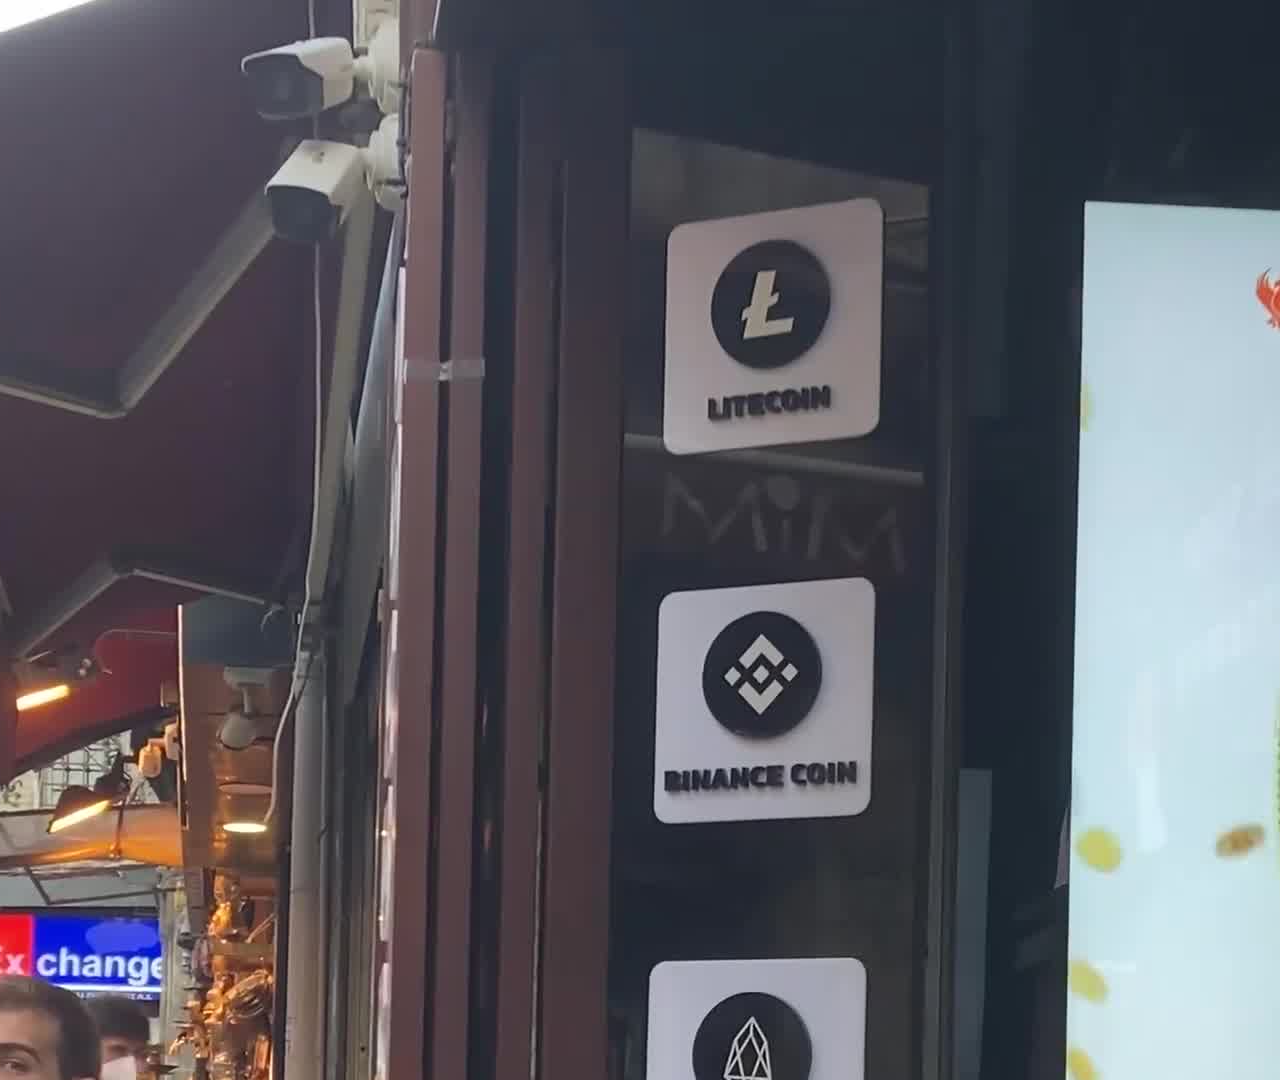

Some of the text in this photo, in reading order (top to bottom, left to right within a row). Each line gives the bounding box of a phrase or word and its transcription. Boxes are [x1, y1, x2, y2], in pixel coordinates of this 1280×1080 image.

[707, 386, 832, 421] LITECOIN
[664, 760, 858, 794] BINANCE COIN
